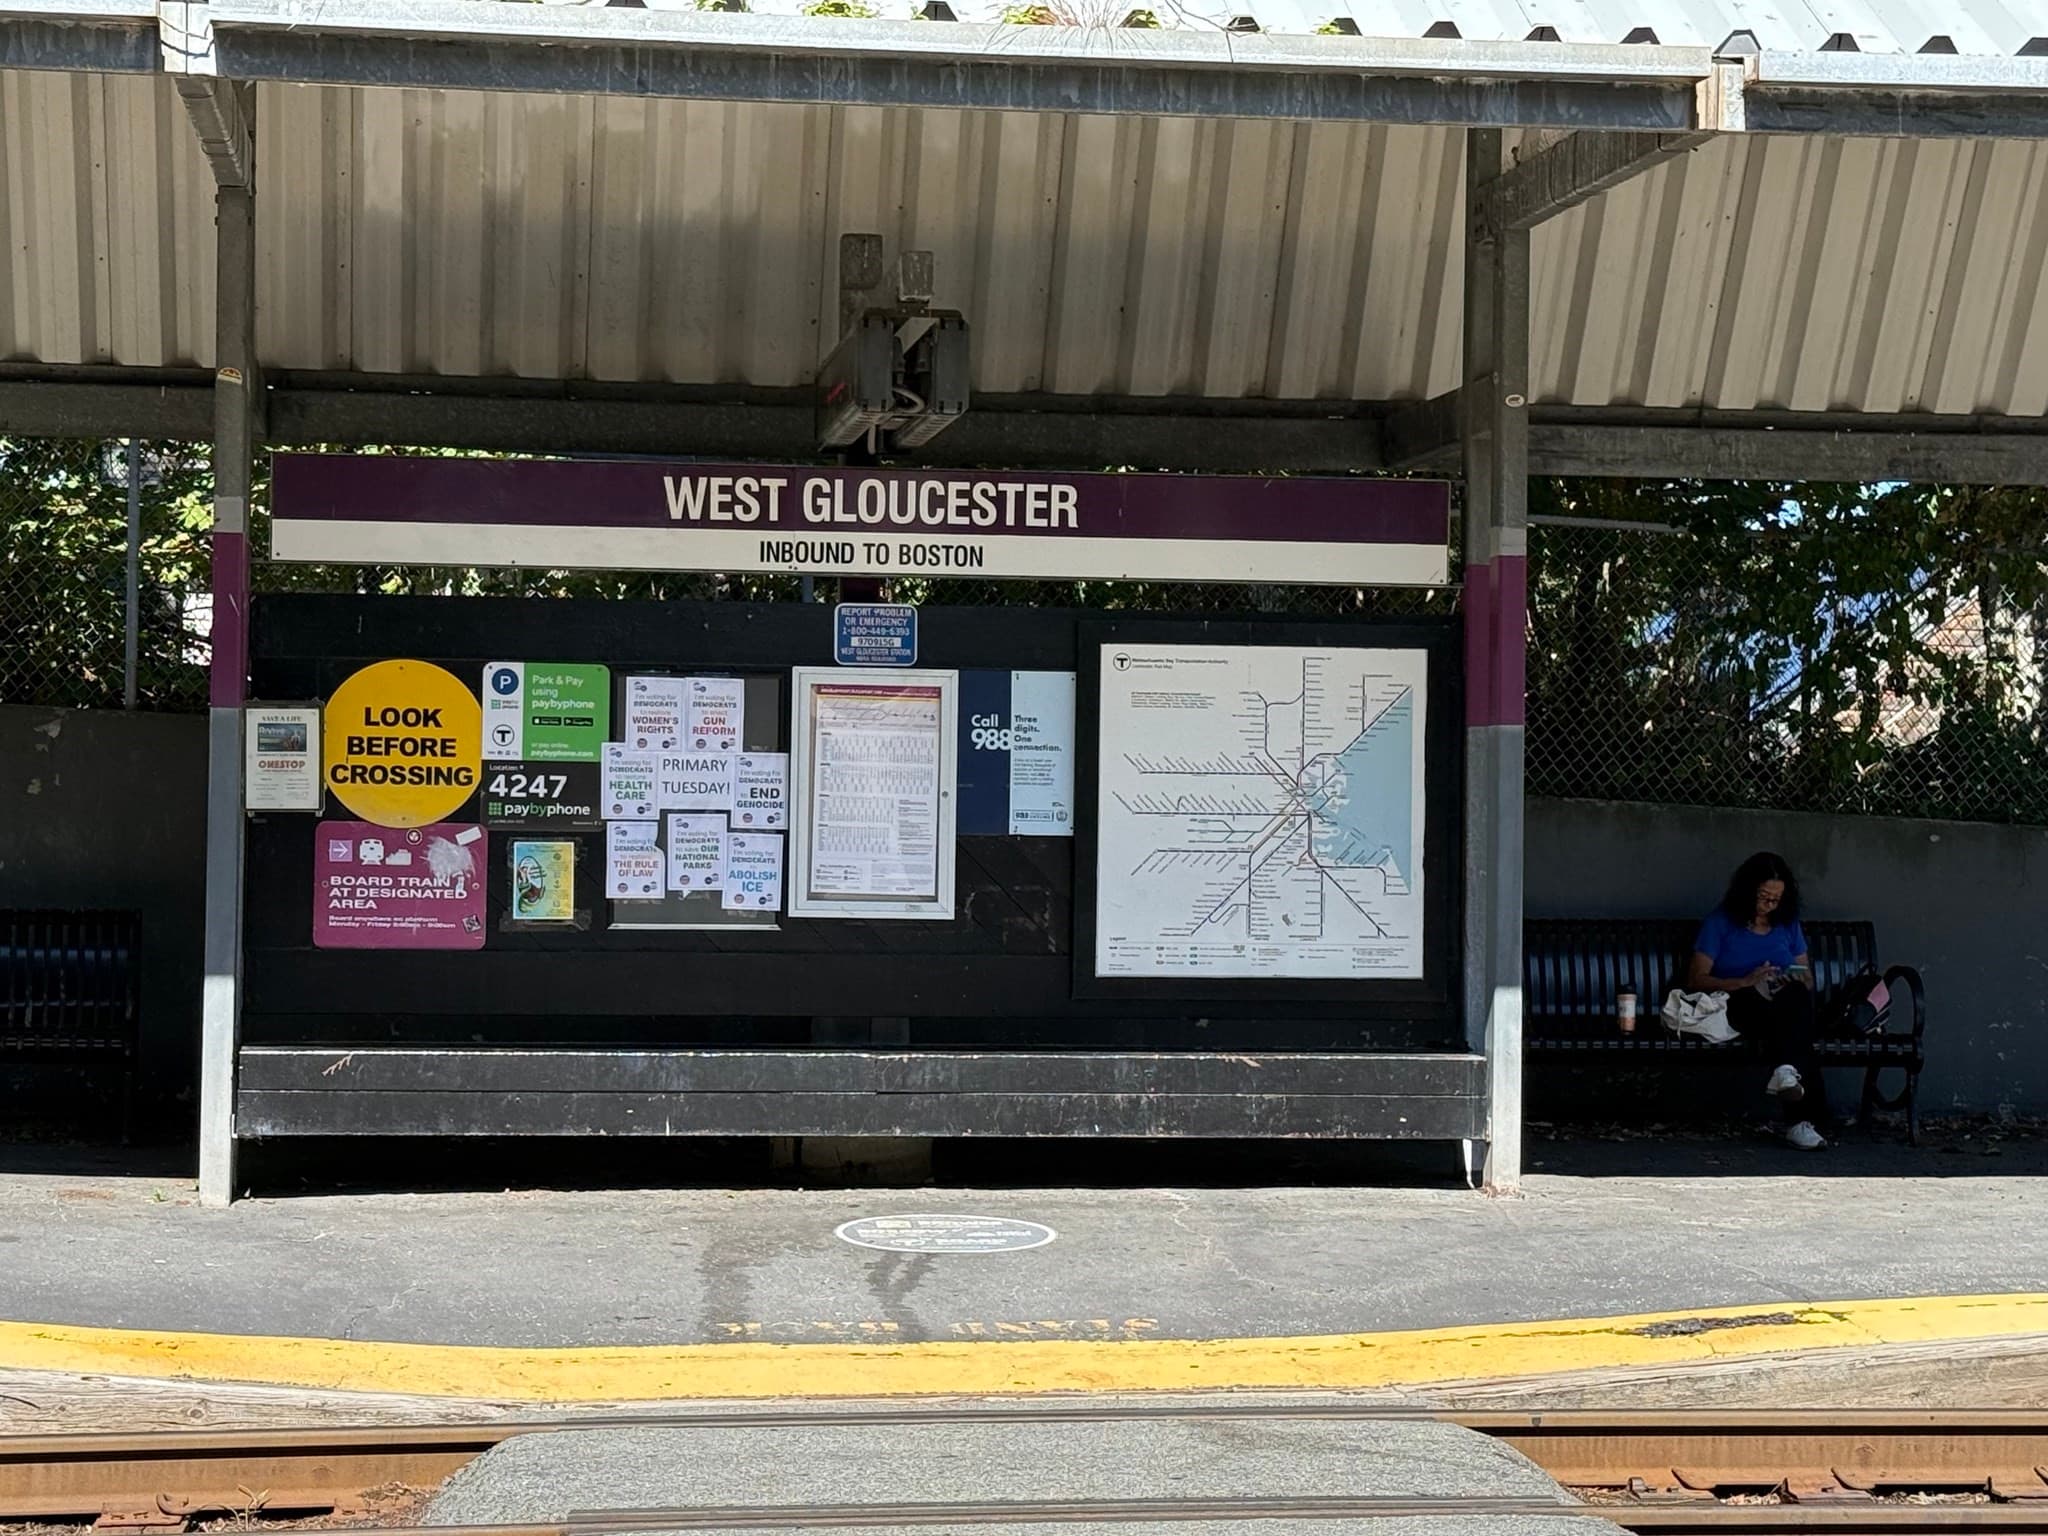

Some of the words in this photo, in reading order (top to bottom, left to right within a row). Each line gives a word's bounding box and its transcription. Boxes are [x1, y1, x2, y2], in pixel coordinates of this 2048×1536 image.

[664, 476, 787, 522] WEST
[803, 478, 1078, 528] GLOUCESTER
[760, 541, 855, 564] INBOUND
[863, 543, 889, 565] TO
[900, 544, 983, 567] BOSTON
[841, 607, 871, 616] REPORT
[873, 608, 912, 617] PROBLEM
[845, 617, 857, 625] OR
[860, 617, 908, 626] EMERGENCY
[1116, 657, 1128, 668] T
[500, 676, 511, 689] P
[532, 675, 554, 684] Park
[556, 676, 563, 685] &
[566, 676, 584, 688] Pay
[532, 688, 558, 698] using
[532, 699, 595, 710] paybyphone
[364, 706, 443, 728] LOOK
[632, 716, 679, 724] WOMEN'S
[703, 717, 725, 725] GUN
[971, 714, 998, 727] Call
[637, 726, 673, 734] RIGHTS
[692, 726, 736, 735] REFORM
[1014, 724, 1040, 733] digits.
[496, 730, 511, 743] T
[971, 728, 1012, 750] 988
[347, 735, 457, 758] BEFORE
[1014, 744, 1062, 752] connection.
[258, 760, 305, 769] ONESTOP
[662, 758, 727, 772] PRIMARY
[330, 764, 473, 787] CROSSING
[489, 774, 567, 798] 4247
[609, 781, 652, 790] HEALTH
[662, 781, 730, 795] TUESDAY!
[616, 791, 646, 800] CARE
[750, 787, 780, 799] END
[505, 803, 591, 817] paybyphone
[736, 800, 784, 809] GENOCIDE
[614, 860, 632, 868] THE
[635, 860, 659, 869] RULE
[619, 869, 631, 877] OF
[633, 869, 654, 877] LAW
[729, 870, 777, 880] ABOLISH
[330, 876, 393, 886] BOARD
[398, 877, 450, 887] TRAIN
[742, 881, 763, 892] ICE
[329, 888, 351, 897] AT
[356, 888, 467, 899] DESIGNATED
[329, 900, 377, 909] AREA
